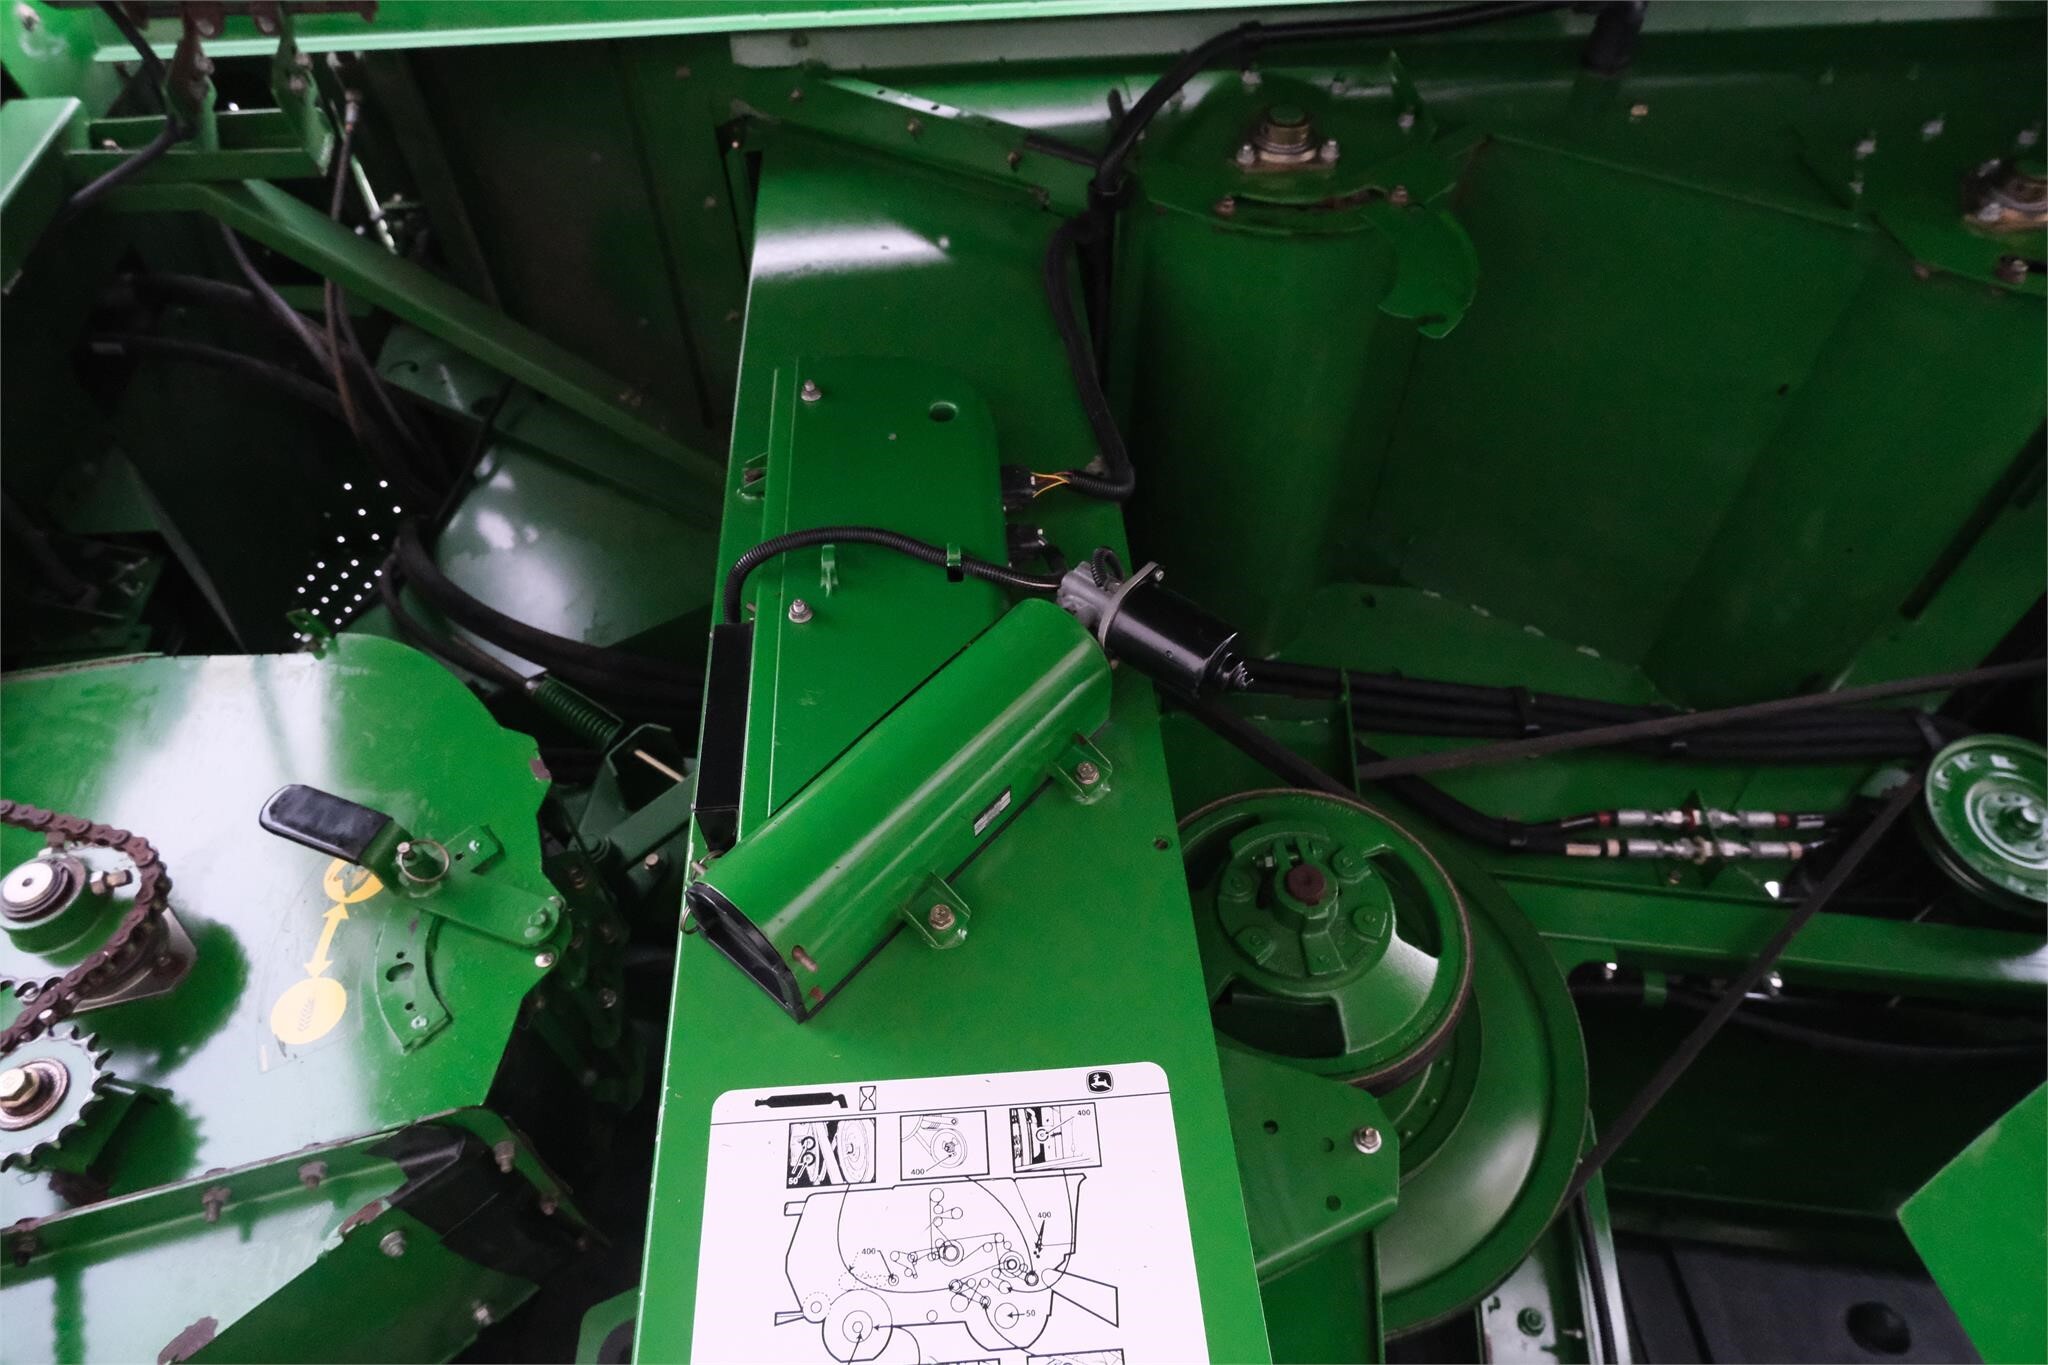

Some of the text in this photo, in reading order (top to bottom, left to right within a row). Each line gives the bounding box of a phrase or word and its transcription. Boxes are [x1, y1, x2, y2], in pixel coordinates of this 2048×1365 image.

[788, 1177, 799, 1185] 50
[861, 1247, 876, 1255] 400
[1026, 1309, 1036, 1317] 50
